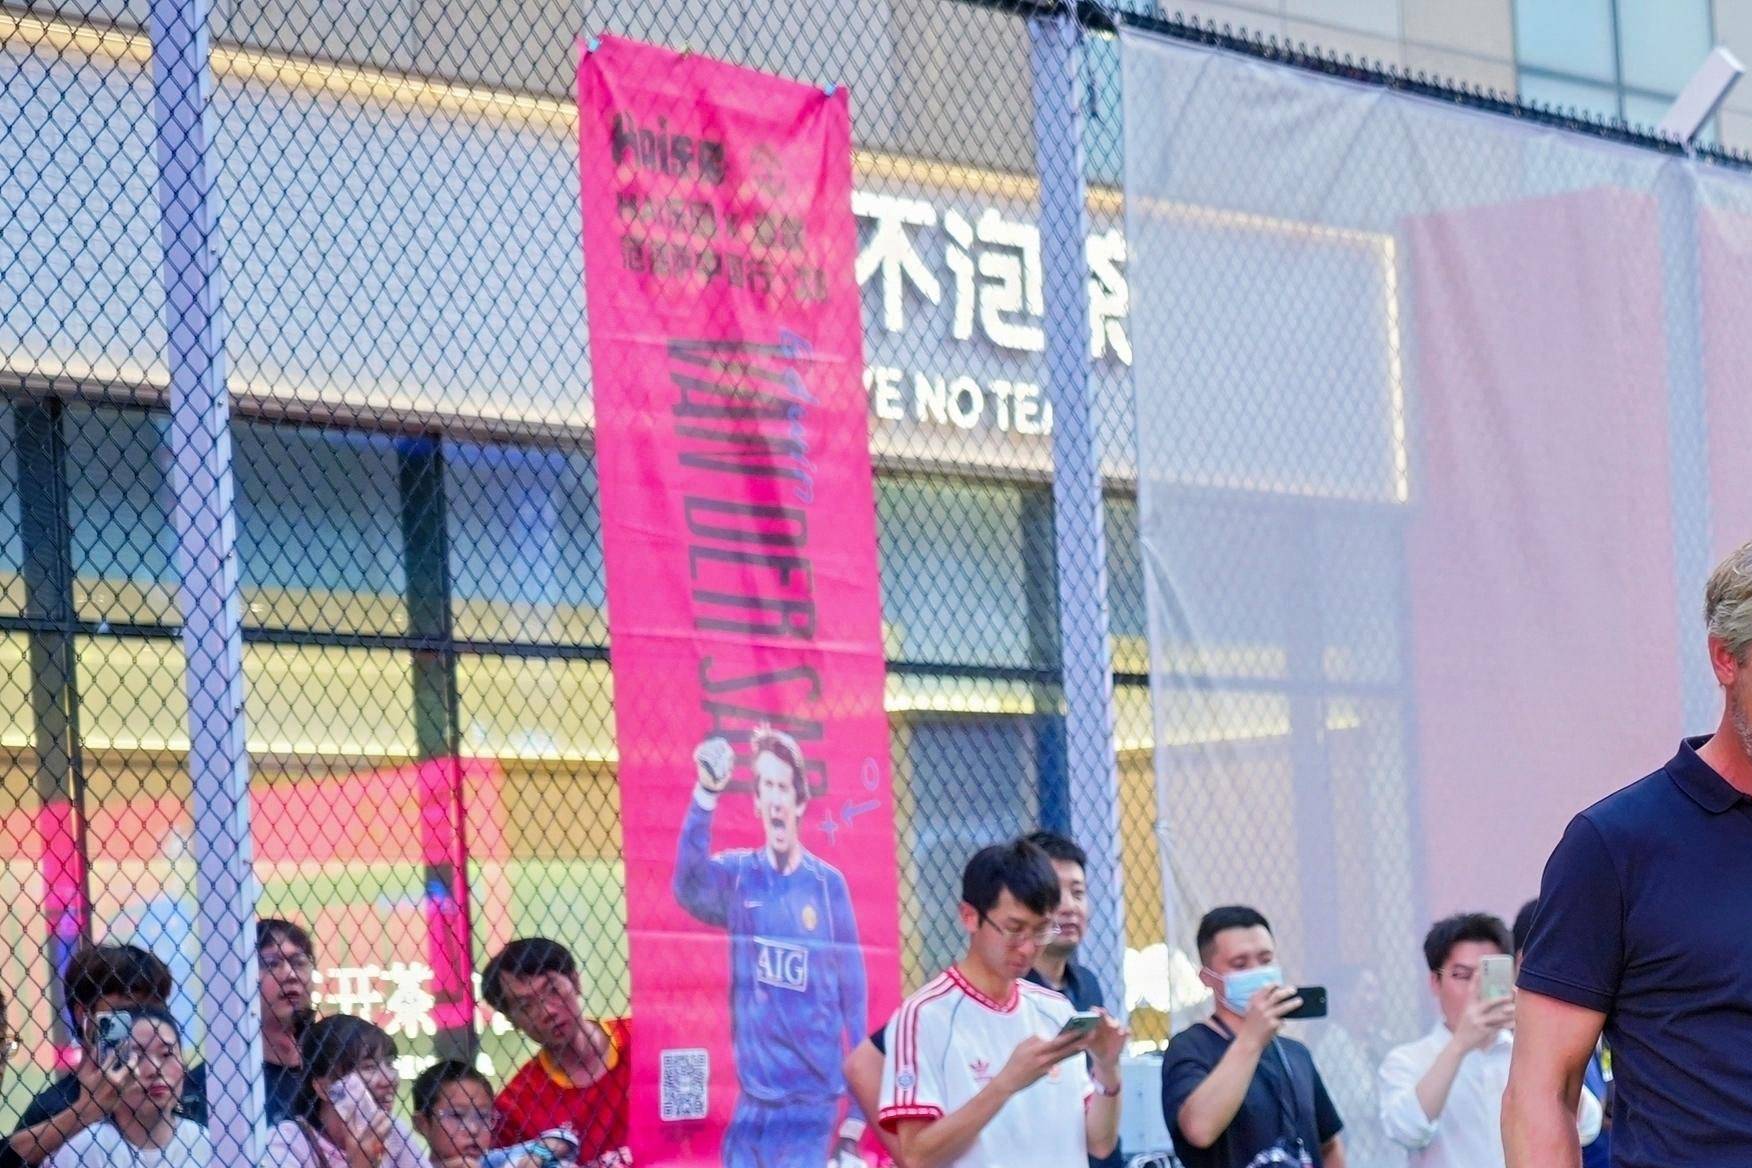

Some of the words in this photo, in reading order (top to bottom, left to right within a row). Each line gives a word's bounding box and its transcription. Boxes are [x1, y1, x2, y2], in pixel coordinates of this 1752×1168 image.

[667, 339, 806, 480] VAN
[914, 371, 984, 429] NO
[989, 380, 1053, 435] TE
[682, 495, 818, 641] DER
[757, 945, 804, 985] AIG
